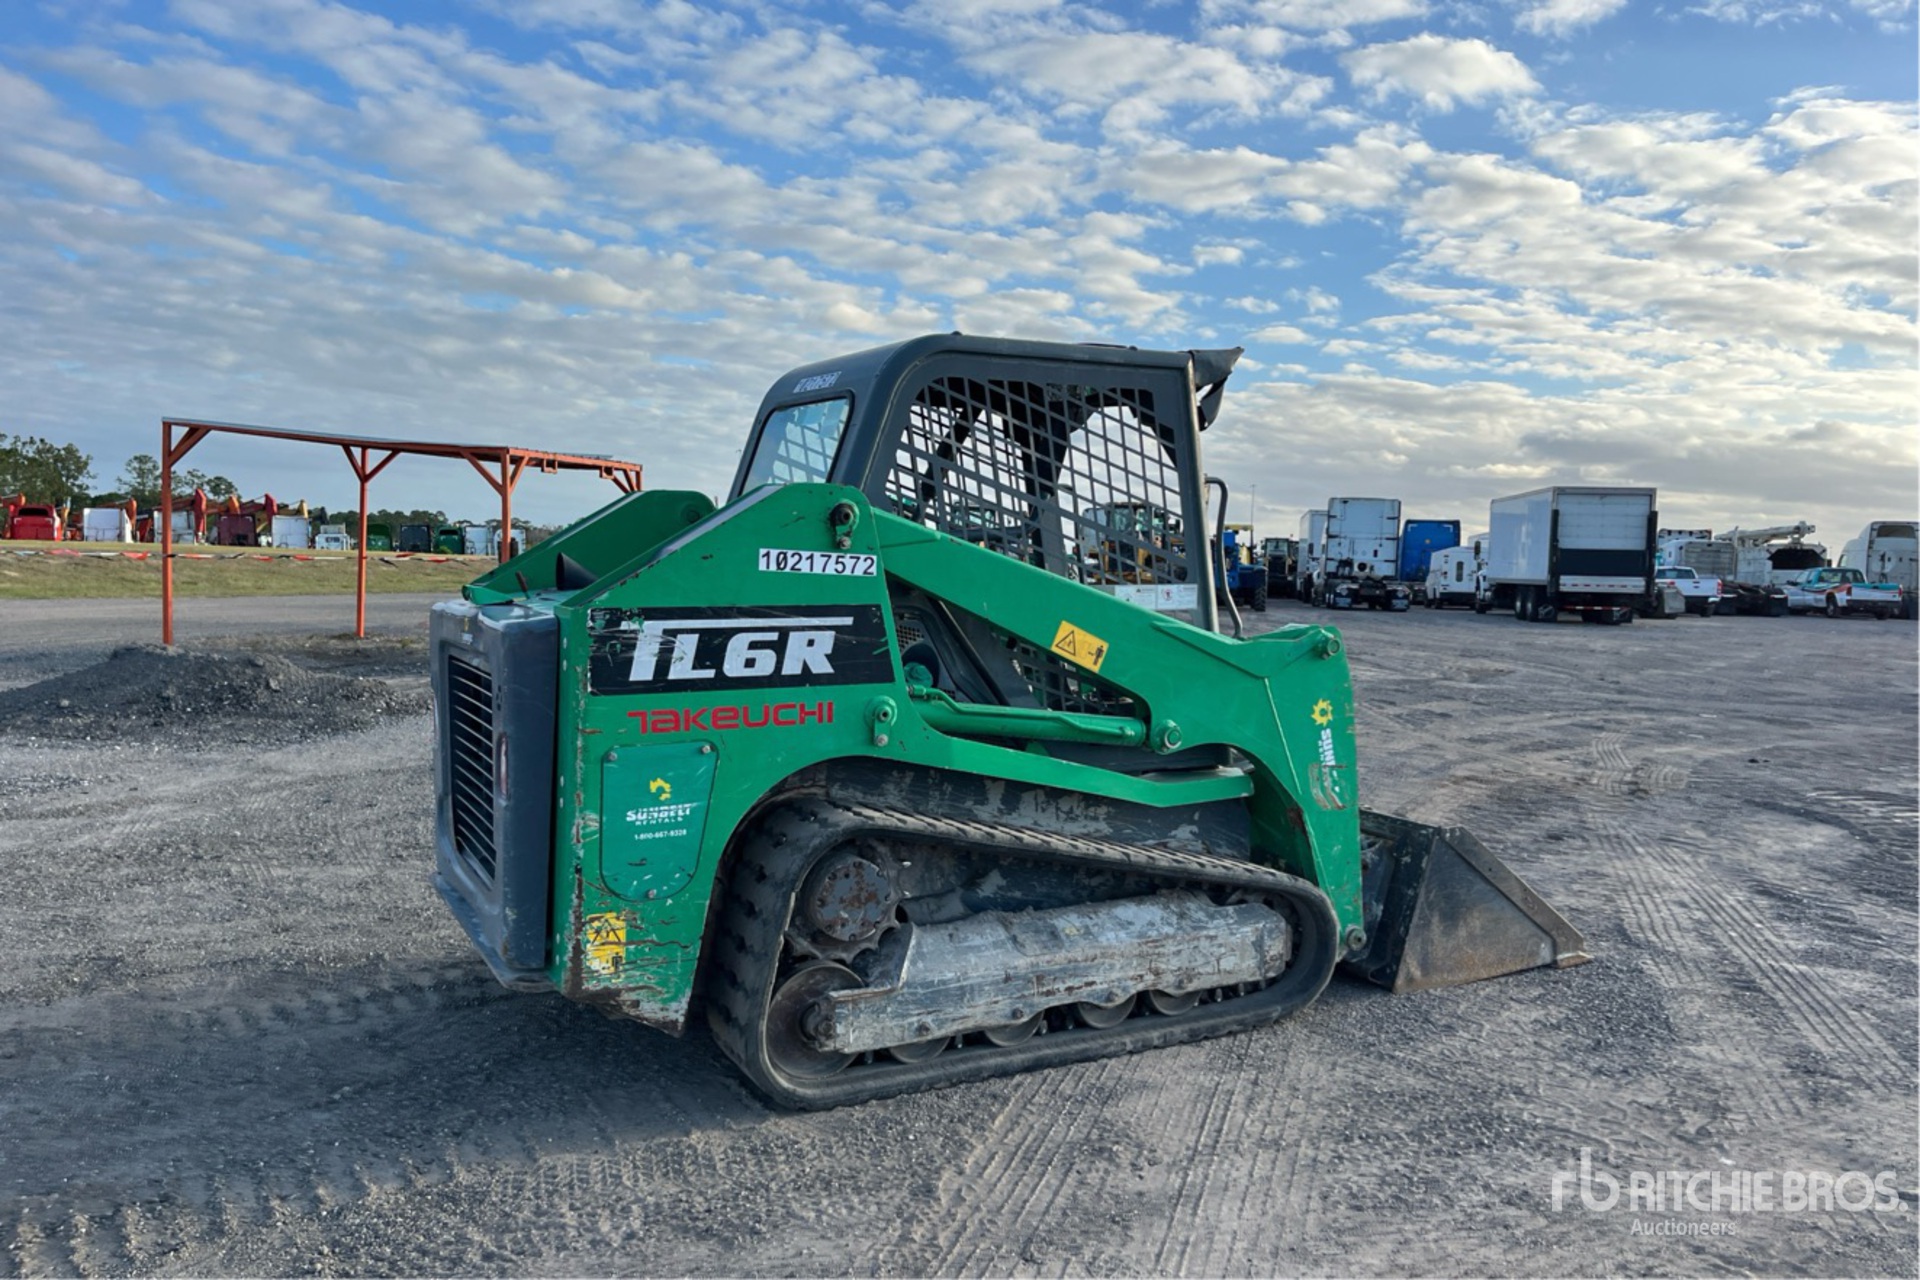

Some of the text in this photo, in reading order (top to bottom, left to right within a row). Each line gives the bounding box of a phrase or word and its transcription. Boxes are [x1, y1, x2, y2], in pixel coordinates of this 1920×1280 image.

[761, 550, 875, 575] 10217572
[620, 617, 854, 681] TL6R
[627, 701, 834, 734] TAKEUCHI
